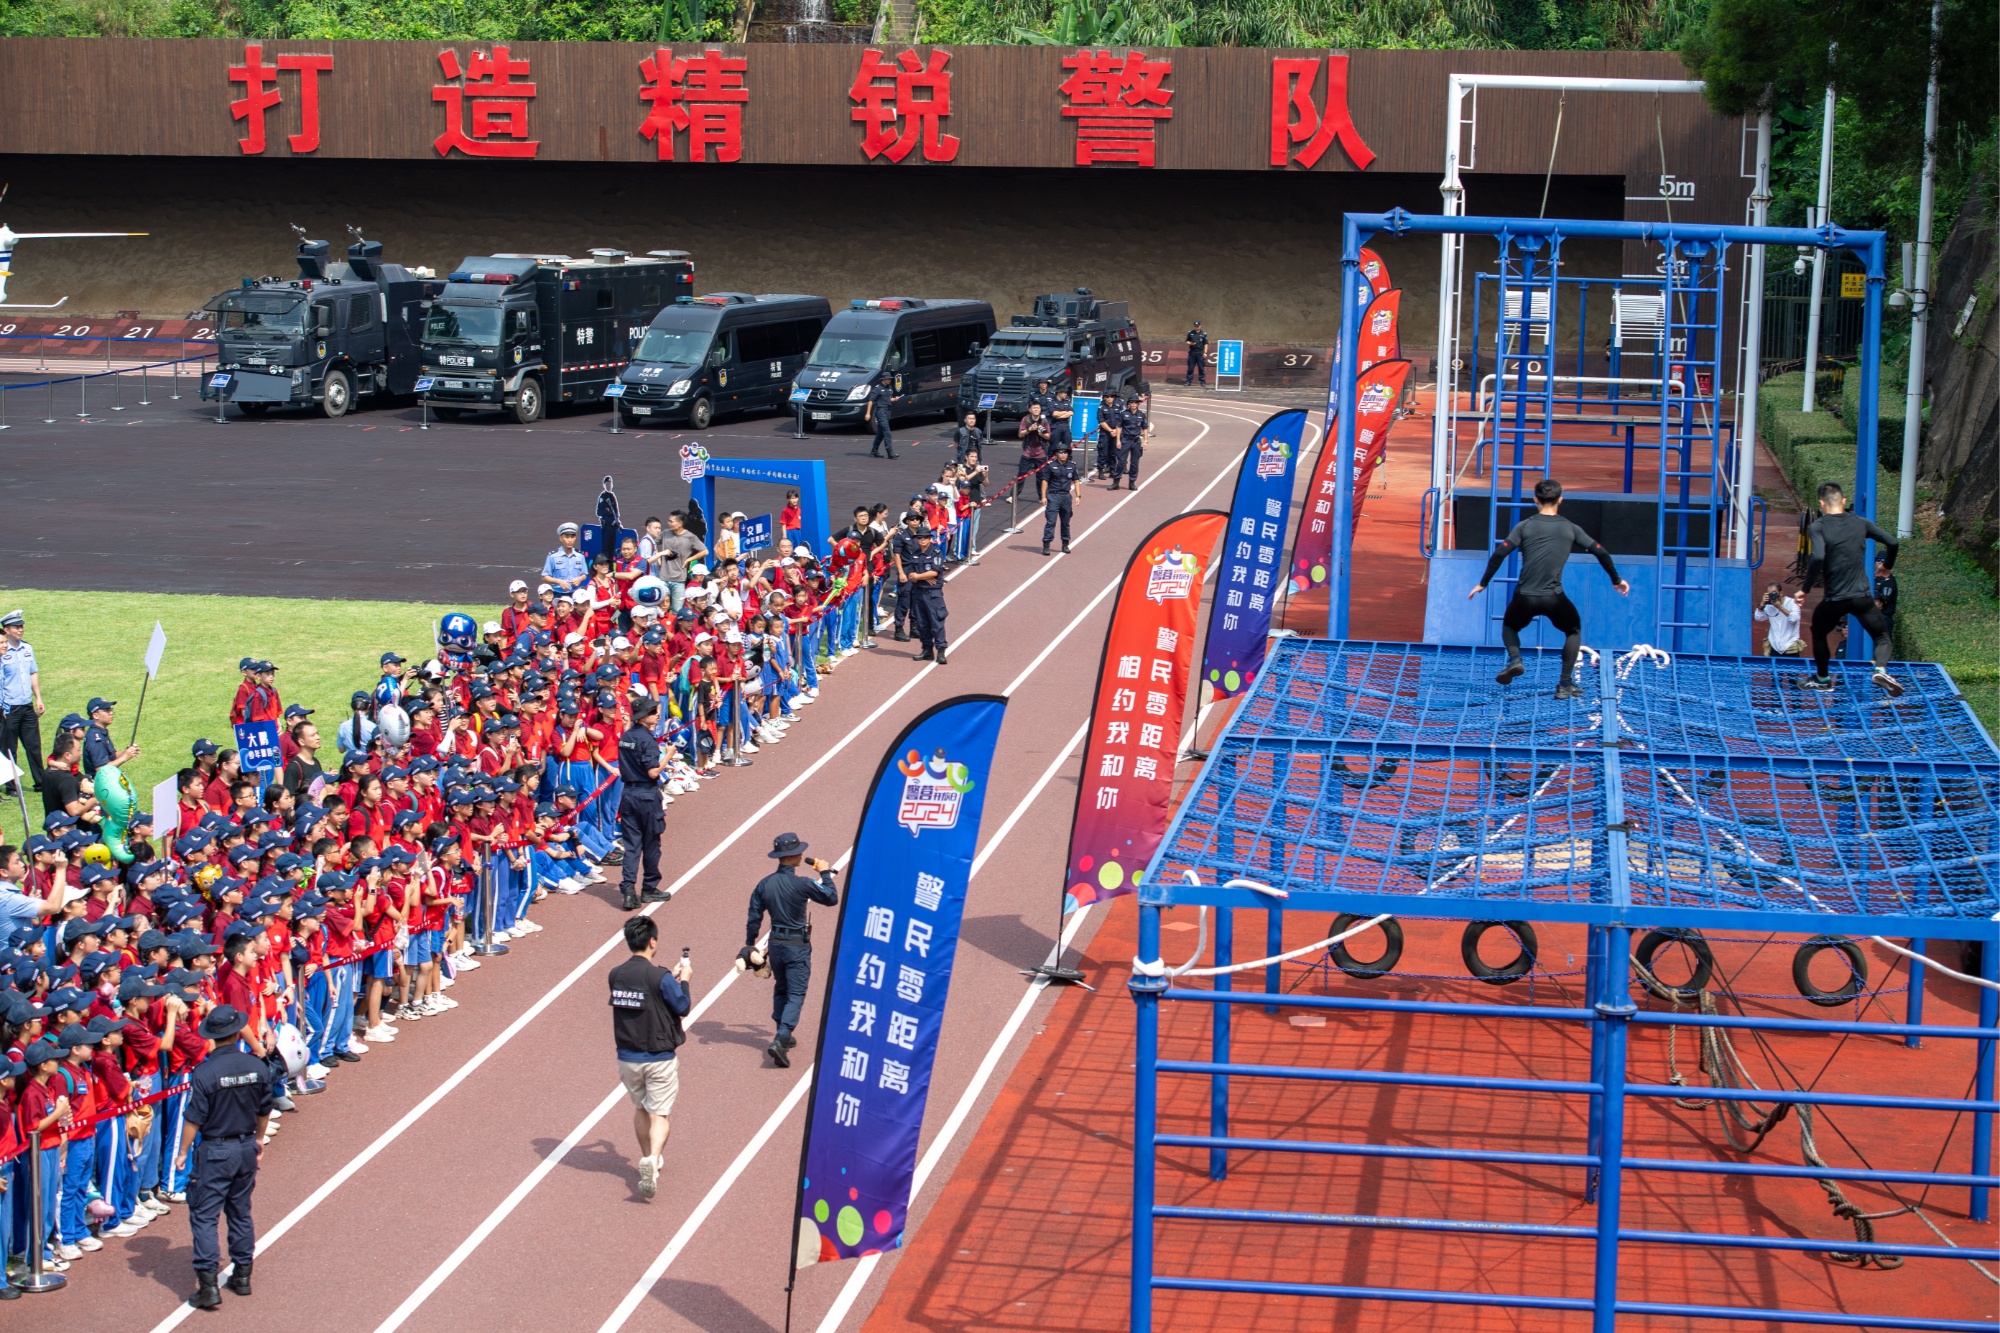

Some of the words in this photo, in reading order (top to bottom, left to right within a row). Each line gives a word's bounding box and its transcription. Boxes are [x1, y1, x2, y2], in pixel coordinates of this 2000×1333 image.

[229, 44, 1377, 171] 打造精锐警队
[1659, 175, 1695, 197] 5m
[0, 324, 17, 335] 9
[54, 325, 91, 337] 20
[123, 326, 155, 339] 21
[577, 327, 594, 345] 特警
[629, 326, 650, 339] POLIC
[1284, 354, 1313, 366] 37
[1249, 498, 1282, 612] 警民零距离
[1223, 517, 1255, 630] 相约我和你
[1149, 581, 1188, 595] 2024
[448, 616, 464, 632] A
[1133, 626, 1179, 781] 警民零距离
[1096, 655, 1141, 810] 相约我和你
[901, 802, 955, 821] 2024
[878, 871, 945, 1095] 警民零距离
[835, 905, 895, 1127] 相约我和你
